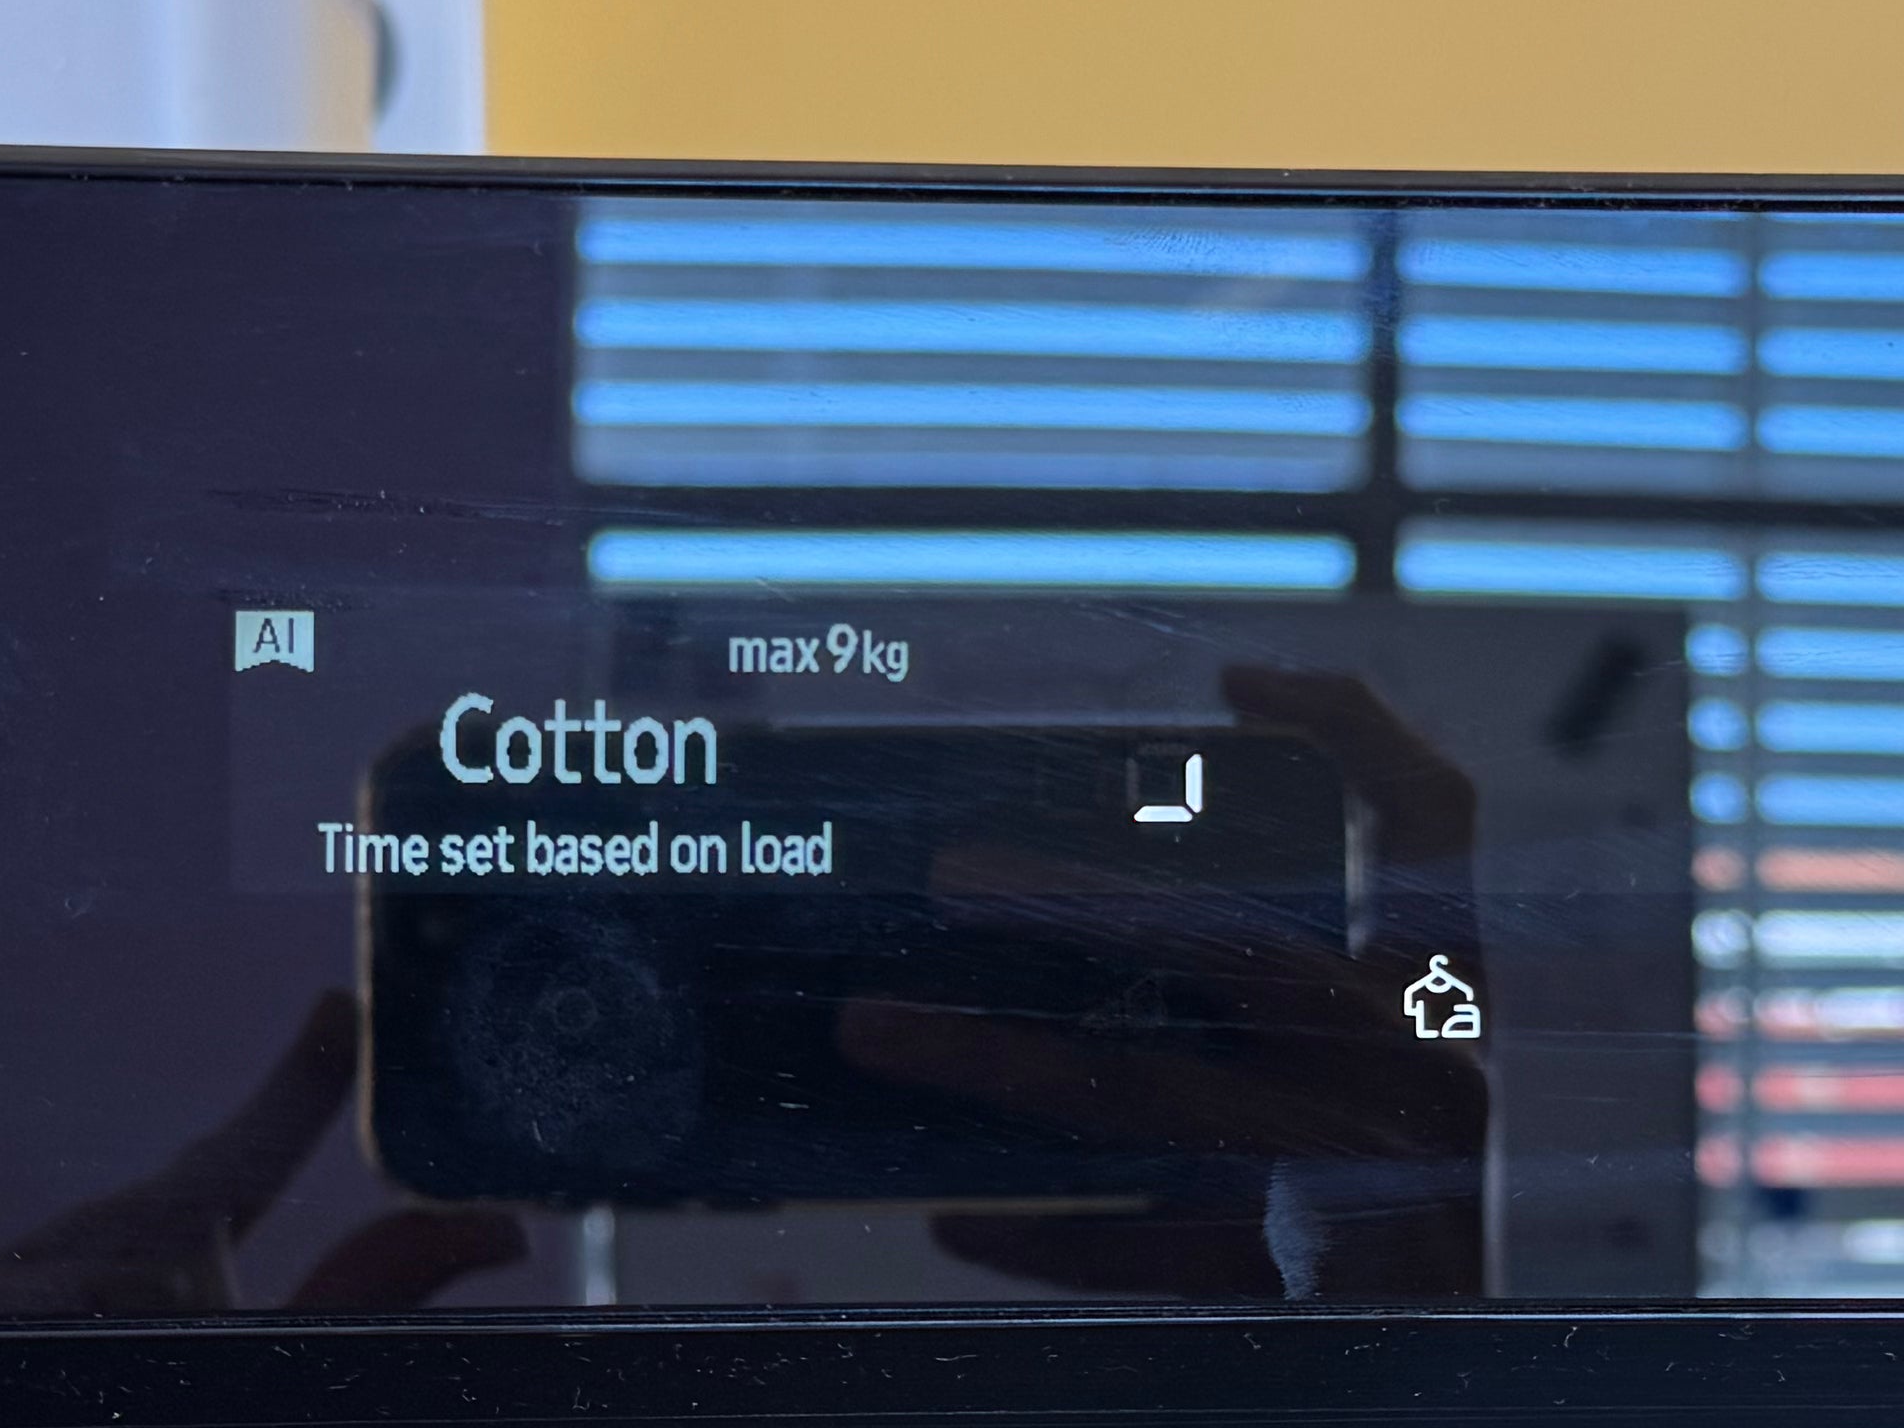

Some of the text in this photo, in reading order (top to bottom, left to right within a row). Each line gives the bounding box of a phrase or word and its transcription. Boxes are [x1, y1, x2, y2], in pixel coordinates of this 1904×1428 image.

[253, 618, 296, 656] AI
[439, 692, 718, 785] Cotton
[317, 820, 834, 875] Time set based on load
